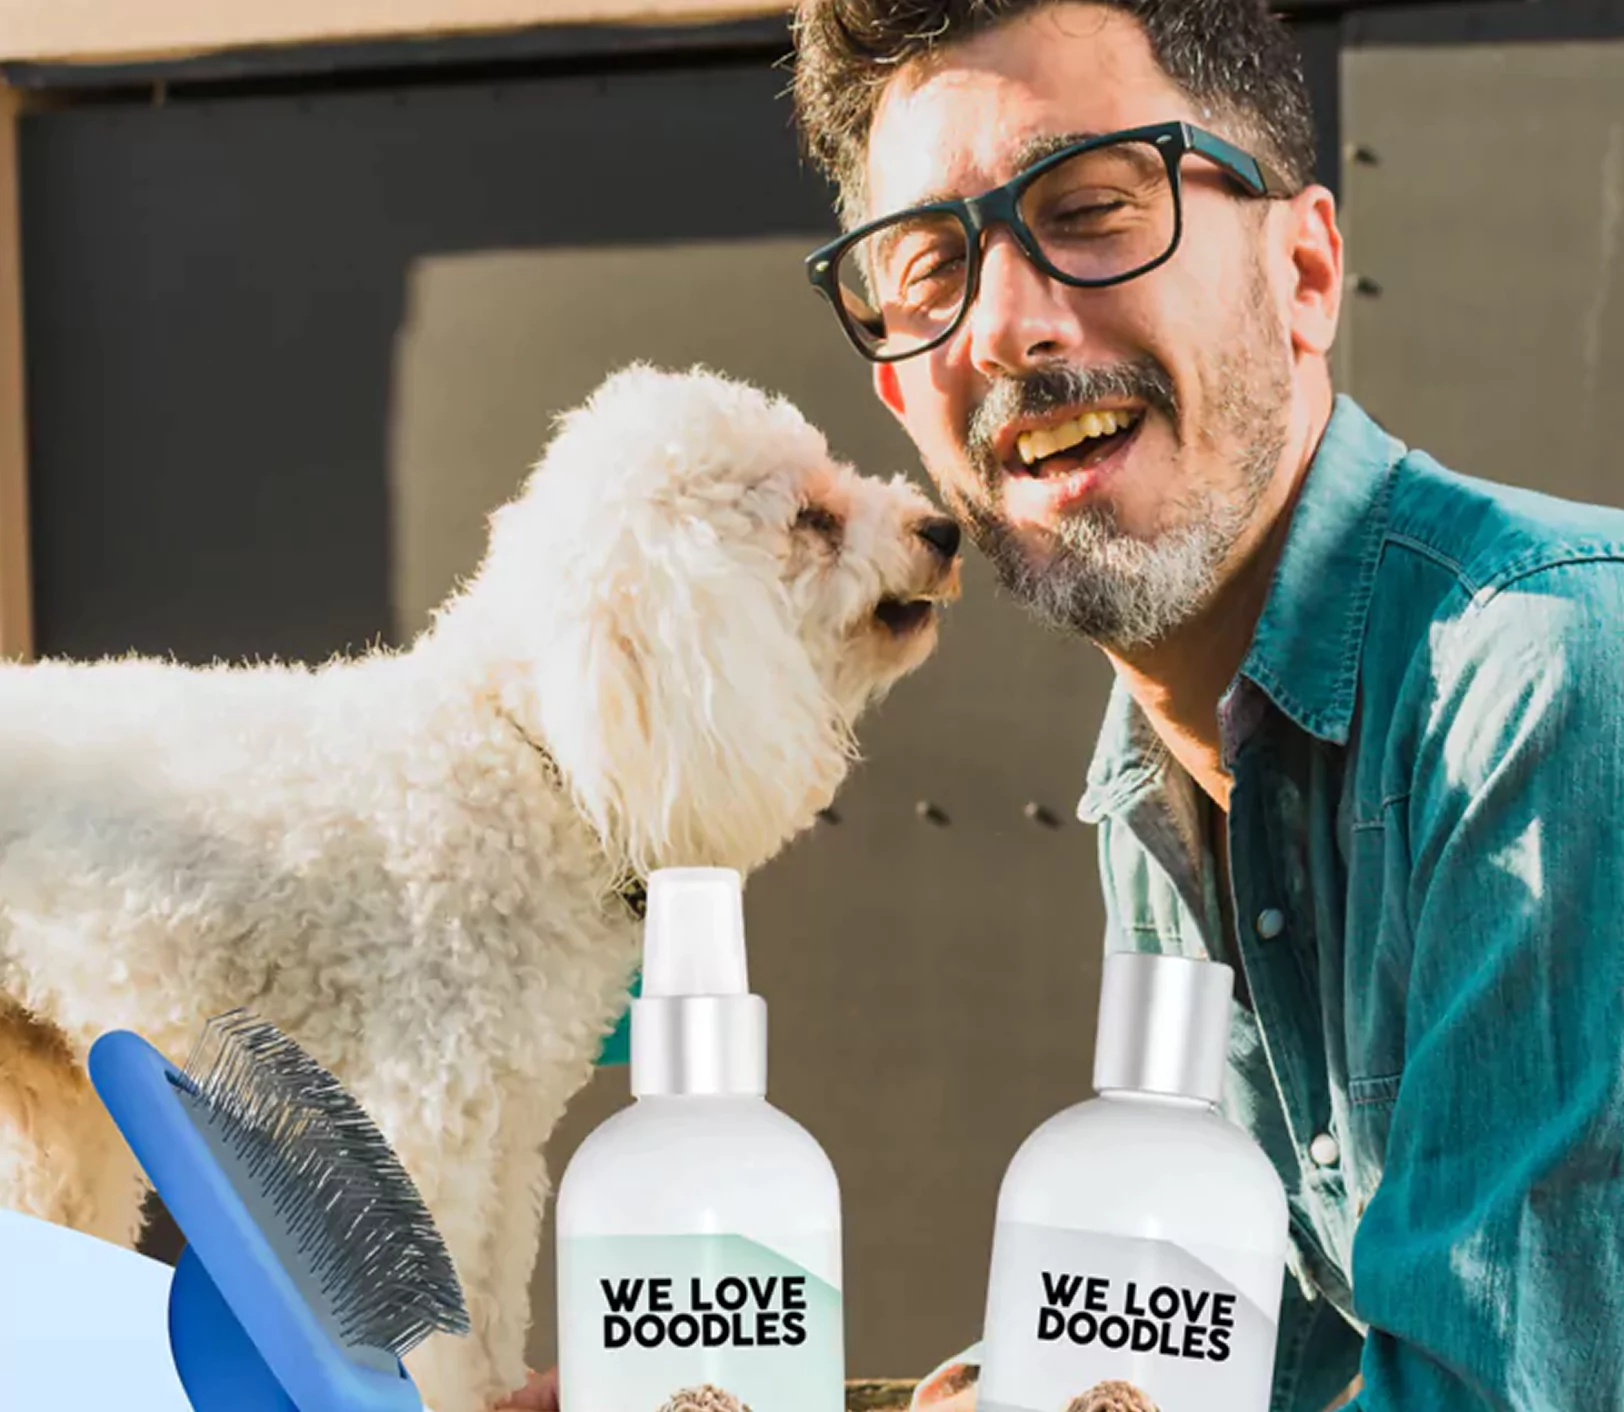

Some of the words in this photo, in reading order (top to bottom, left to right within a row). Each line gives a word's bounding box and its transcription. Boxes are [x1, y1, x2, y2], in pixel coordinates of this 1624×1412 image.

[601, 1278, 673, 1313] WE
[691, 1276, 807, 1312] LOVE
[1041, 1271, 1110, 1312] WE
[1124, 1282, 1237, 1328] LOVE
[603, 1311, 807, 1349] DOODLES
[1037, 1306, 1231, 1362] DOODLES
